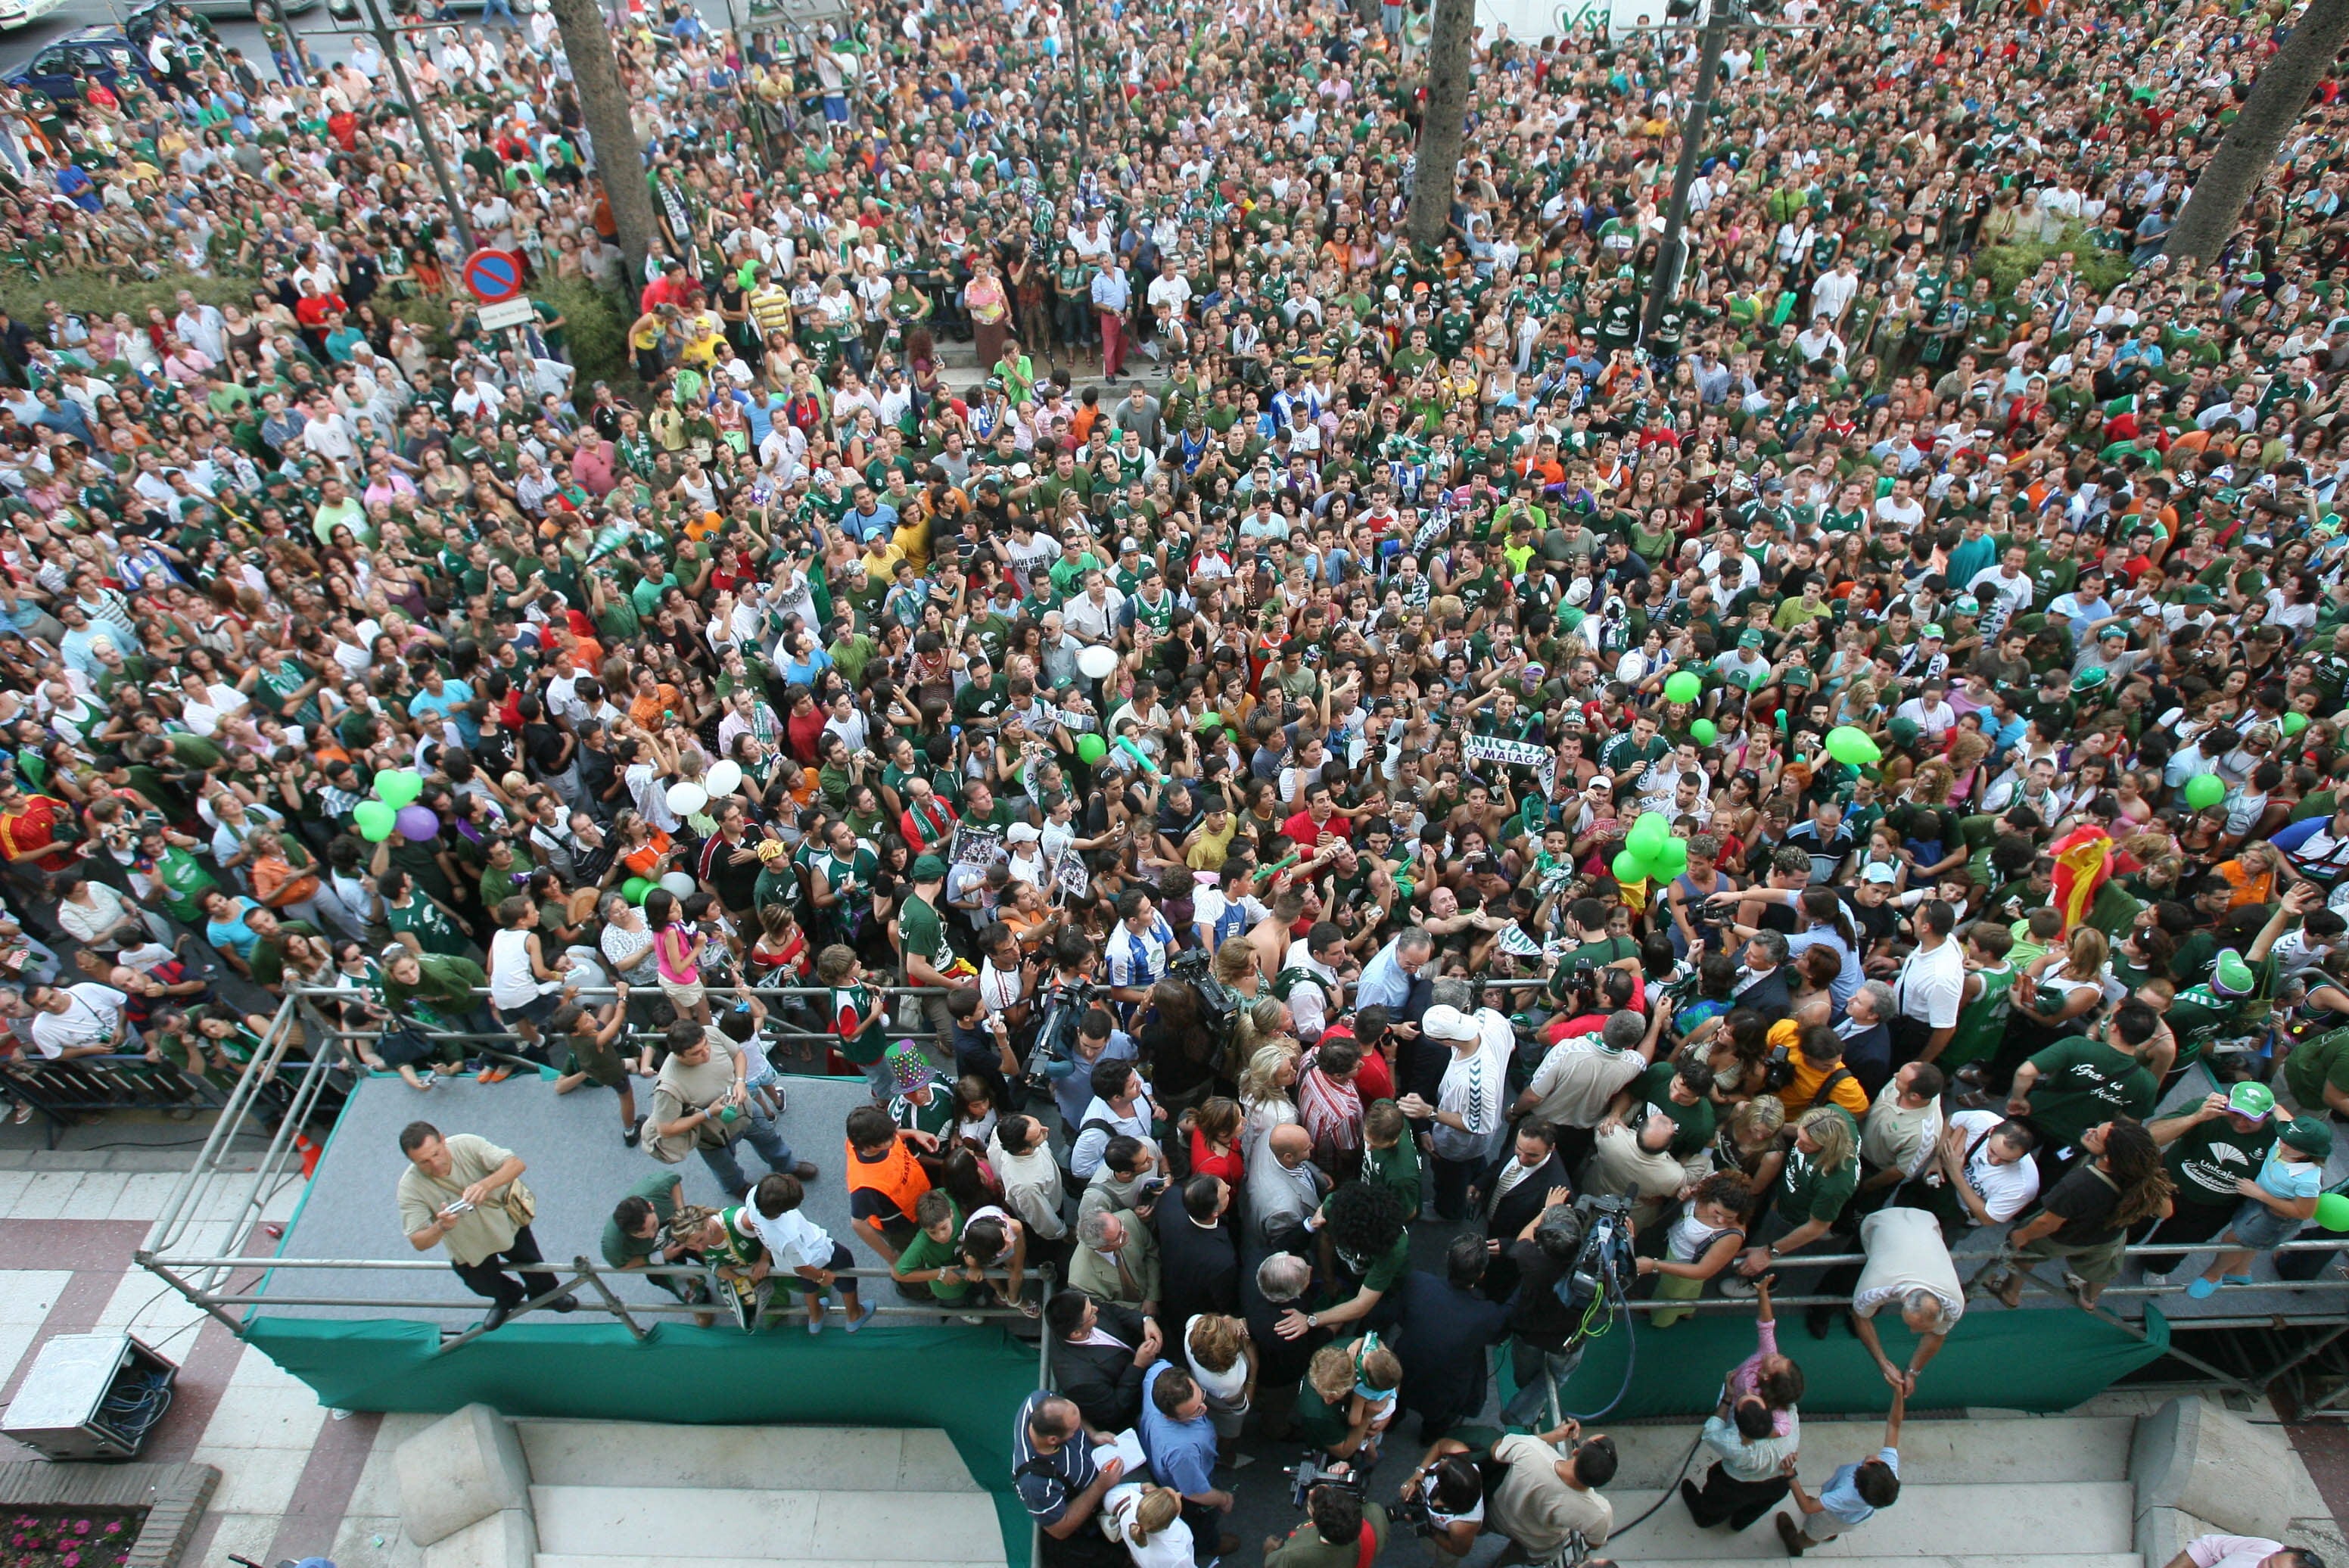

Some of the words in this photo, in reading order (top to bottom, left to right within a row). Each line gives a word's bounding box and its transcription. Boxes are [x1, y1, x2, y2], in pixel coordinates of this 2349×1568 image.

[1150, 616, 1160, 626] 12
[1462, 735, 1546, 758] UNICAJA
[1483, 749, 1543, 765] MALAGA
[2200, 1159, 2235, 1181] Unicaja
